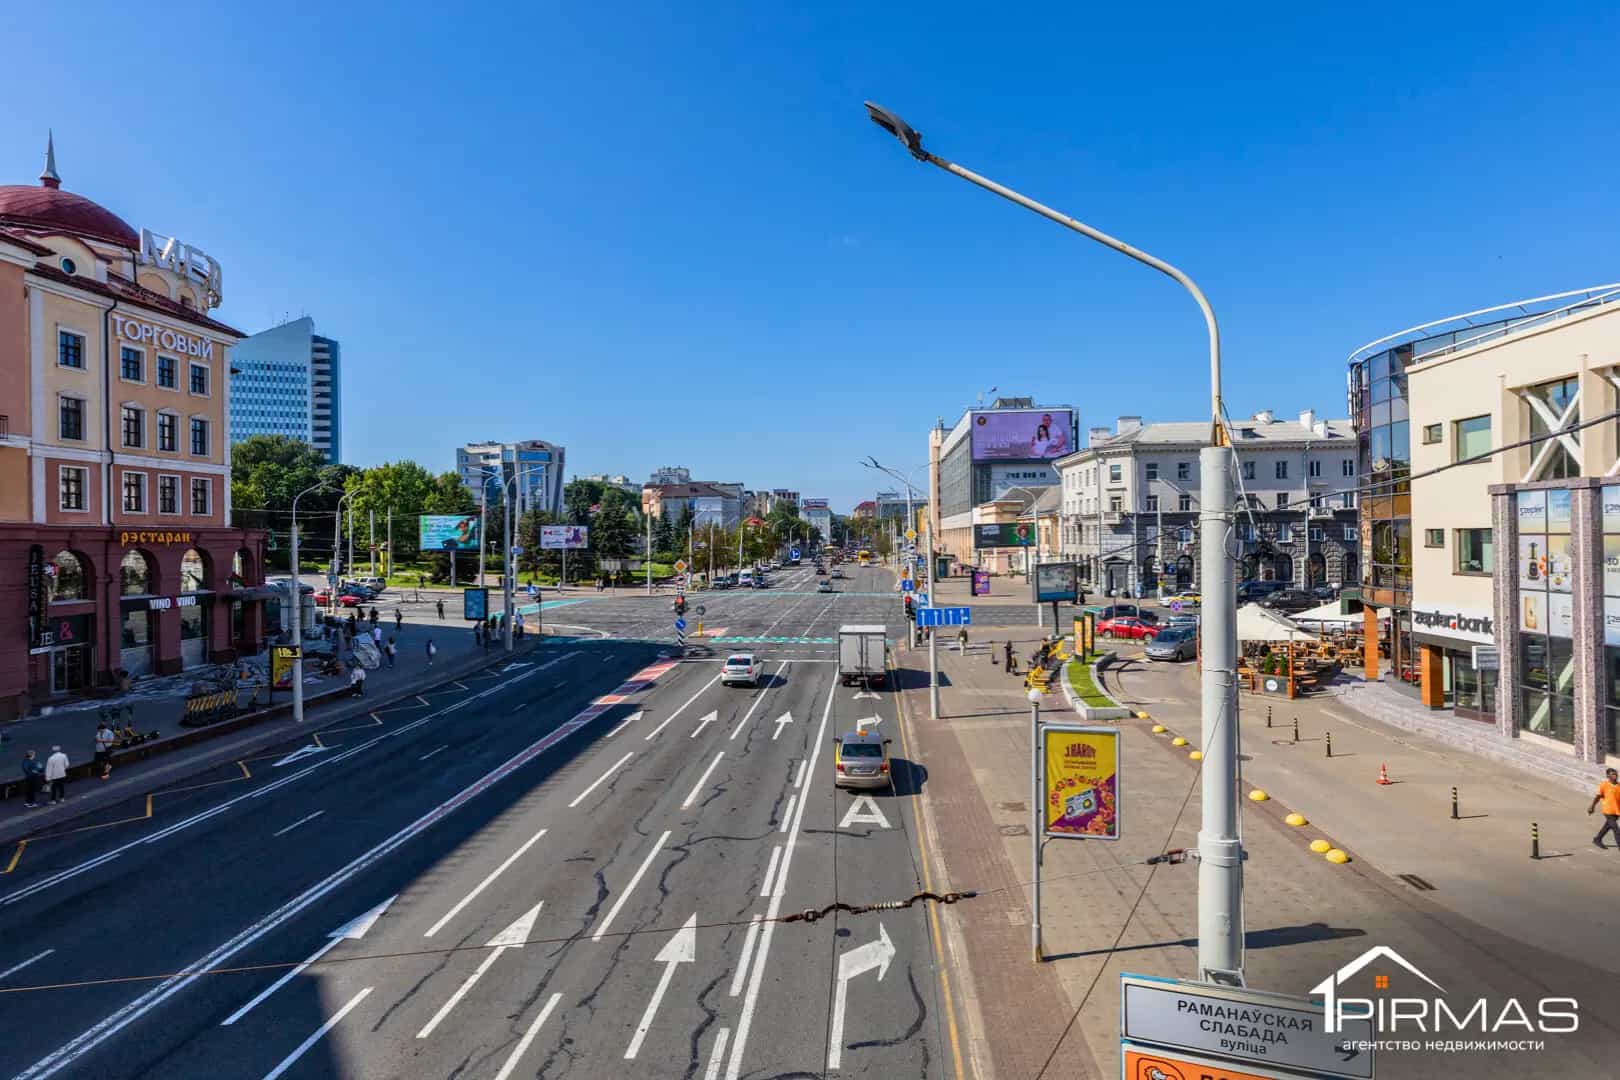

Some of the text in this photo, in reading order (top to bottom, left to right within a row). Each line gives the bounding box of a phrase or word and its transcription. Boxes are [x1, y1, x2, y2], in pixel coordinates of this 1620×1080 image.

[112, 315, 213, 360] ТОРГОВЫЙ
[121, 531, 191, 548] рэстаран
[149, 595, 196, 609] VINO VINO
[1177, 1000, 1313, 1031] РАМАНАЎСКАЯ
[1200, 1019, 1288, 1044] СЛАБАДА
[1221, 1039, 1267, 1055] вуліца
